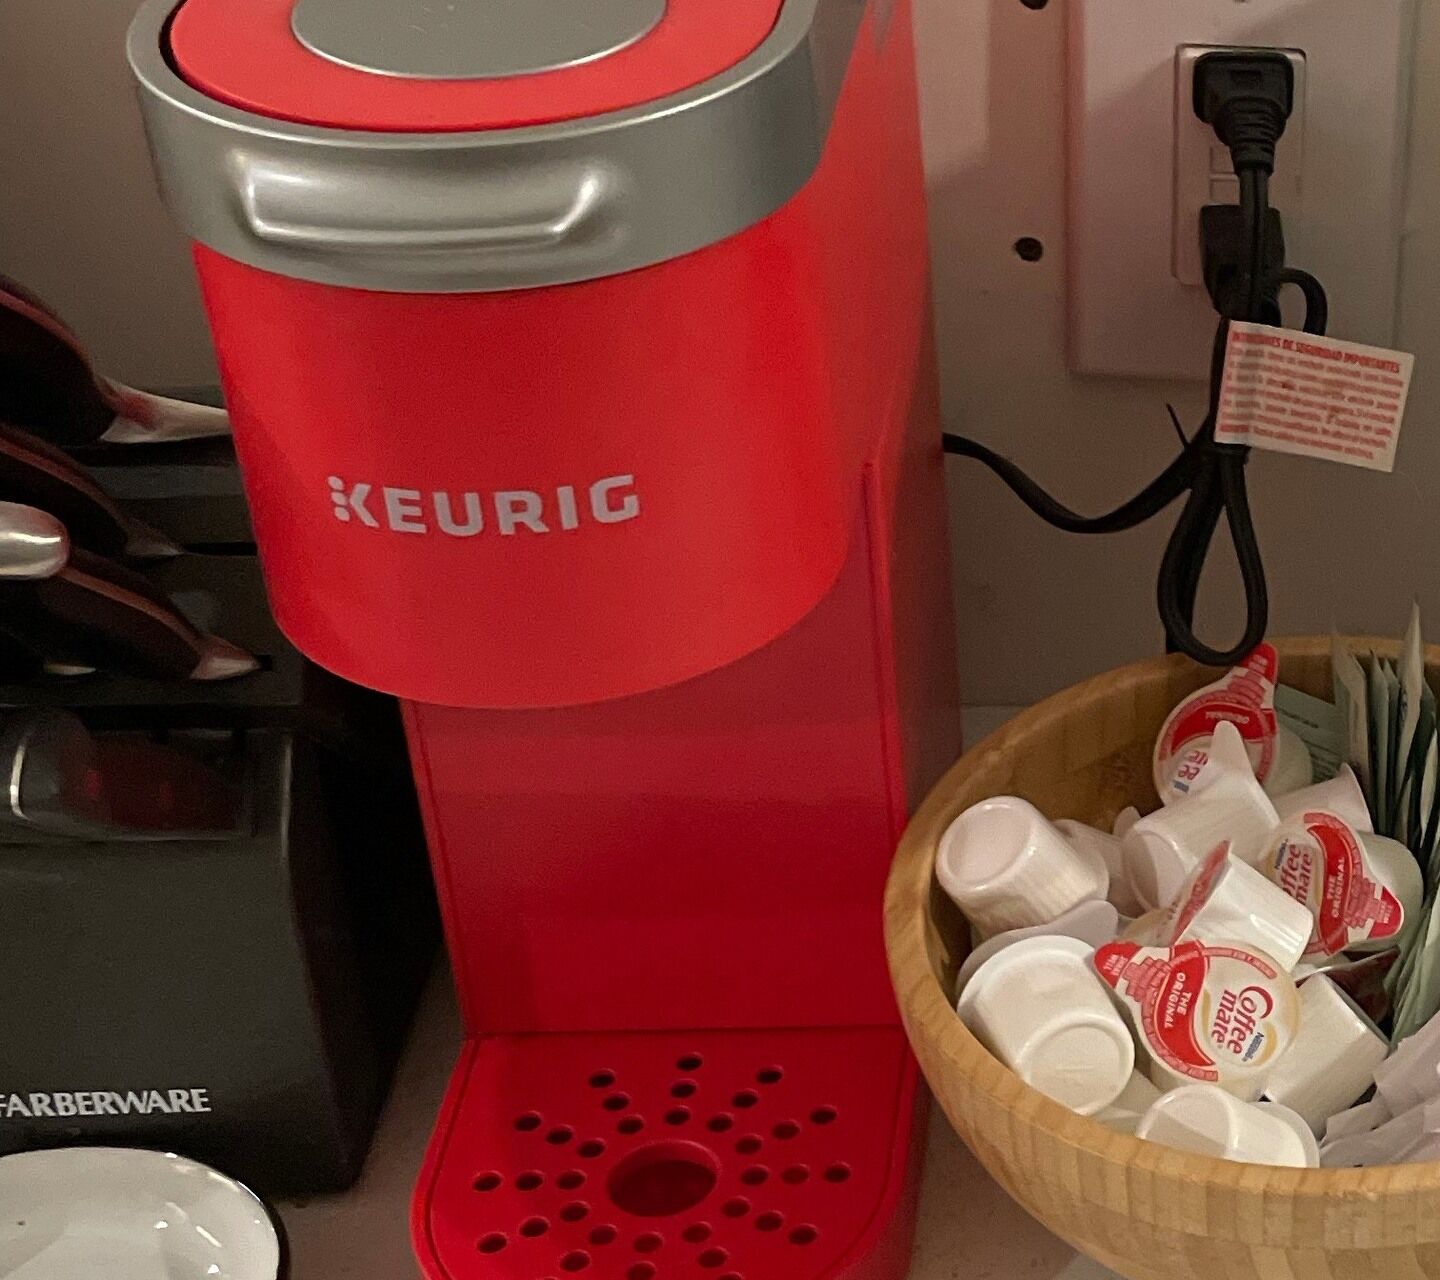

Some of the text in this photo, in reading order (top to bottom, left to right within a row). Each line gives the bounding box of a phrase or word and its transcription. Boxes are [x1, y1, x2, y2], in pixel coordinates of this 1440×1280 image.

[327, 474, 641, 537] KEURIG
[1331, 857, 1345, 918] ORIGINAL
[1164, 972, 1186, 1029] ORIGINAL
[1177, 992, 1193, 1016] THE
[1227, 985, 1274, 1055] Coffee
